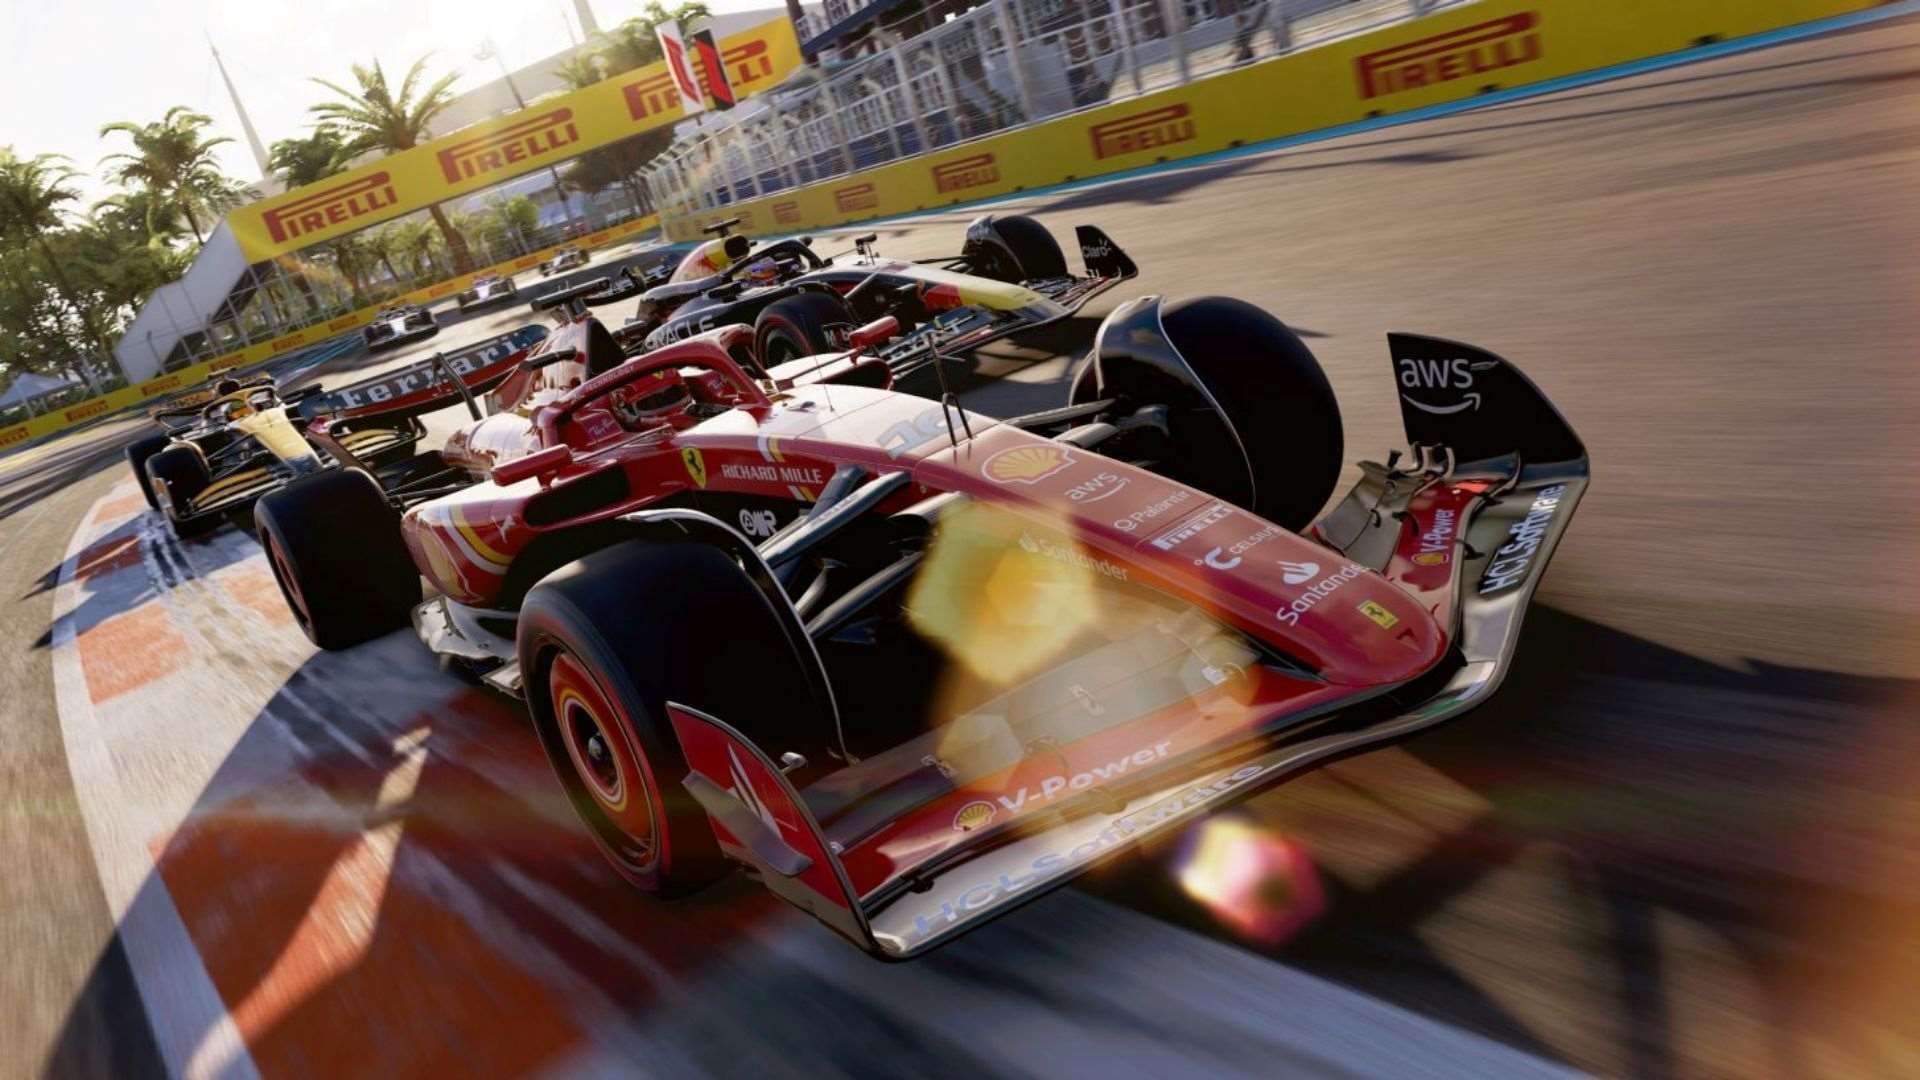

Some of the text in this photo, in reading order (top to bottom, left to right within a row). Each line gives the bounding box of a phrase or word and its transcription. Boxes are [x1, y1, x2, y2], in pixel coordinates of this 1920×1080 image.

[1355, 10, 1542, 100] PIRELLI
[436, 106, 580, 185] PIRELLI
[261, 170, 398, 244] PIRELLI
[338, 333, 521, 409] Ferrari
[1400, 358, 1473, 389] aws
[720, 463, 823, 485] RICHARD MILLE
[1064, 473, 1118, 500] aws
[1130, 490, 1191, 524] Palantir
[998, 741, 1172, 814] V-Power
